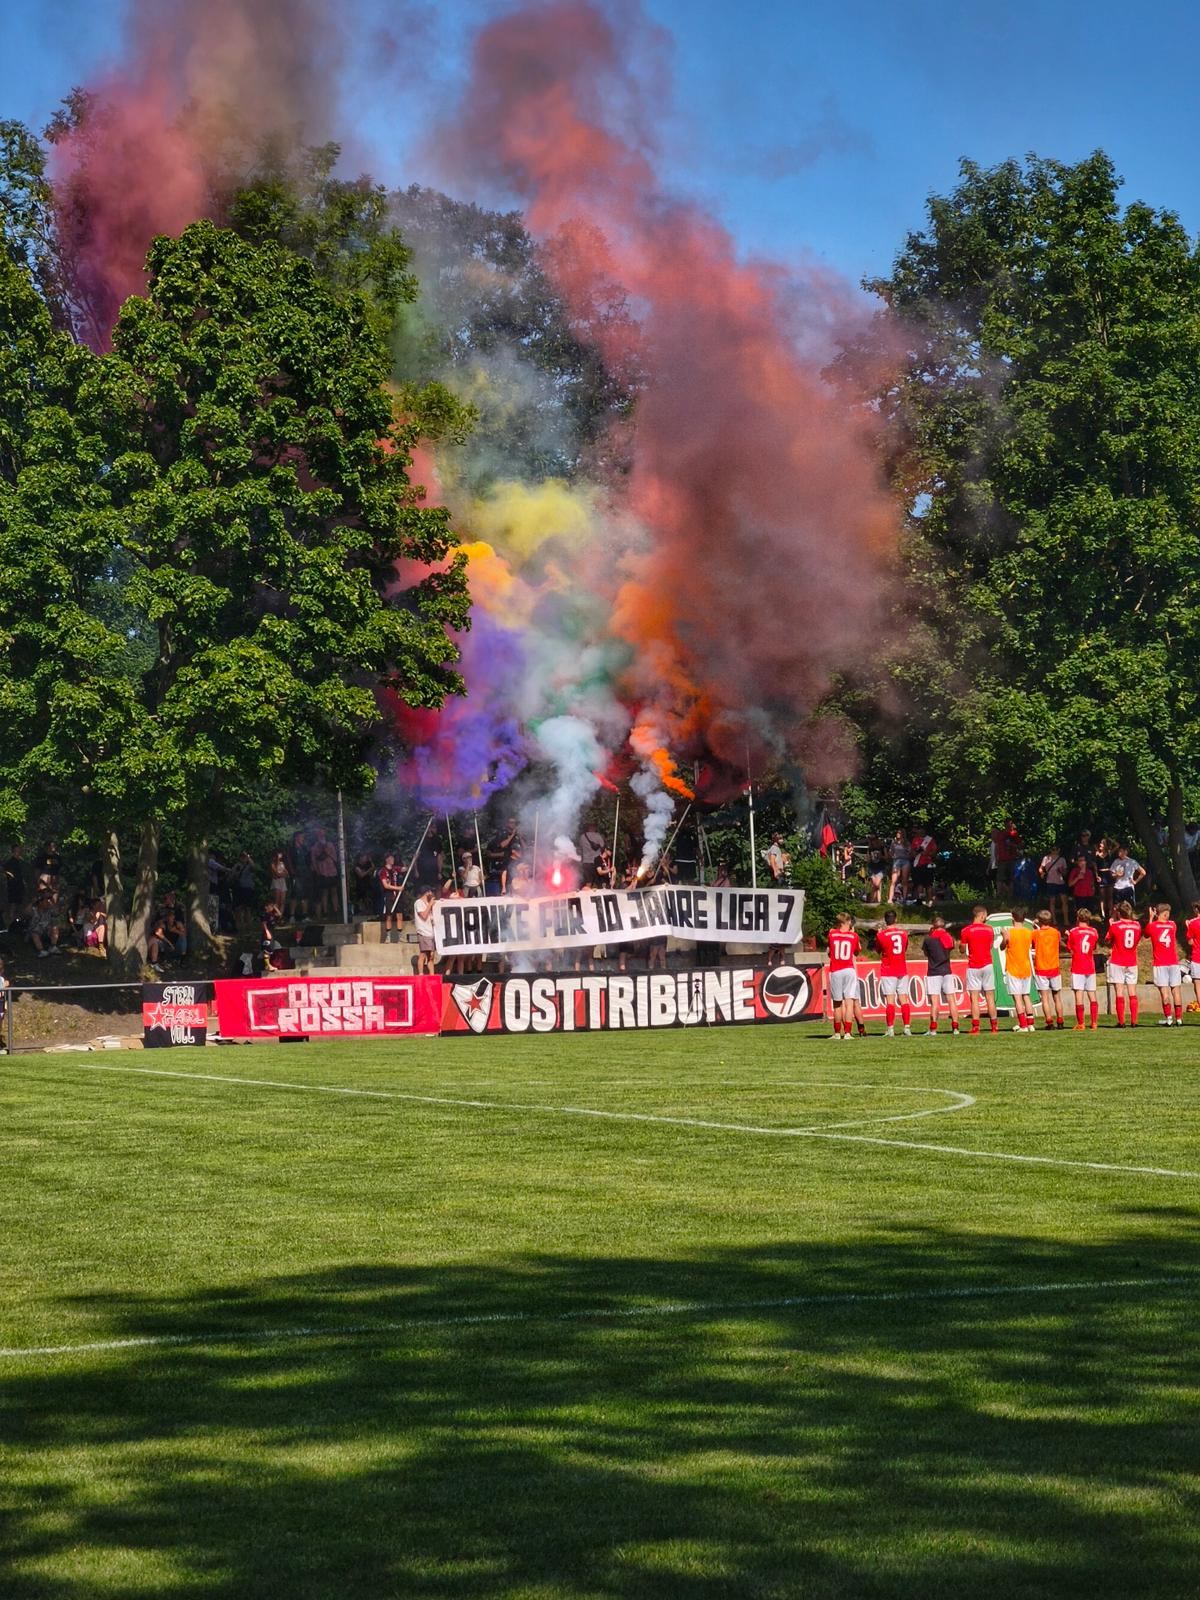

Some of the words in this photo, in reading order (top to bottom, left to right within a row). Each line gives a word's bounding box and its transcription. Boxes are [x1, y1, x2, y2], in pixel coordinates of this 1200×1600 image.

[440, 903, 530, 947] DANKE
[539, 897, 587, 937] FÜR
[590, 894, 624, 933] 10
[627, 890, 707, 930] JAHRE
[715, 892, 769, 932] LIGA
[778, 894, 794, 932] 7
[891, 934, 903, 955] 3
[1081, 934, 1090, 954] 6
[1124, 929, 1135, 948] 8
[1159, 928, 1171, 948] 4
[833, 940, 851, 960] 10
[287, 982, 373, 1009] ORDA
[505, 968, 755, 1032] OSTTRIBÜNE
[278, 1005, 384, 1033] ROSSA
